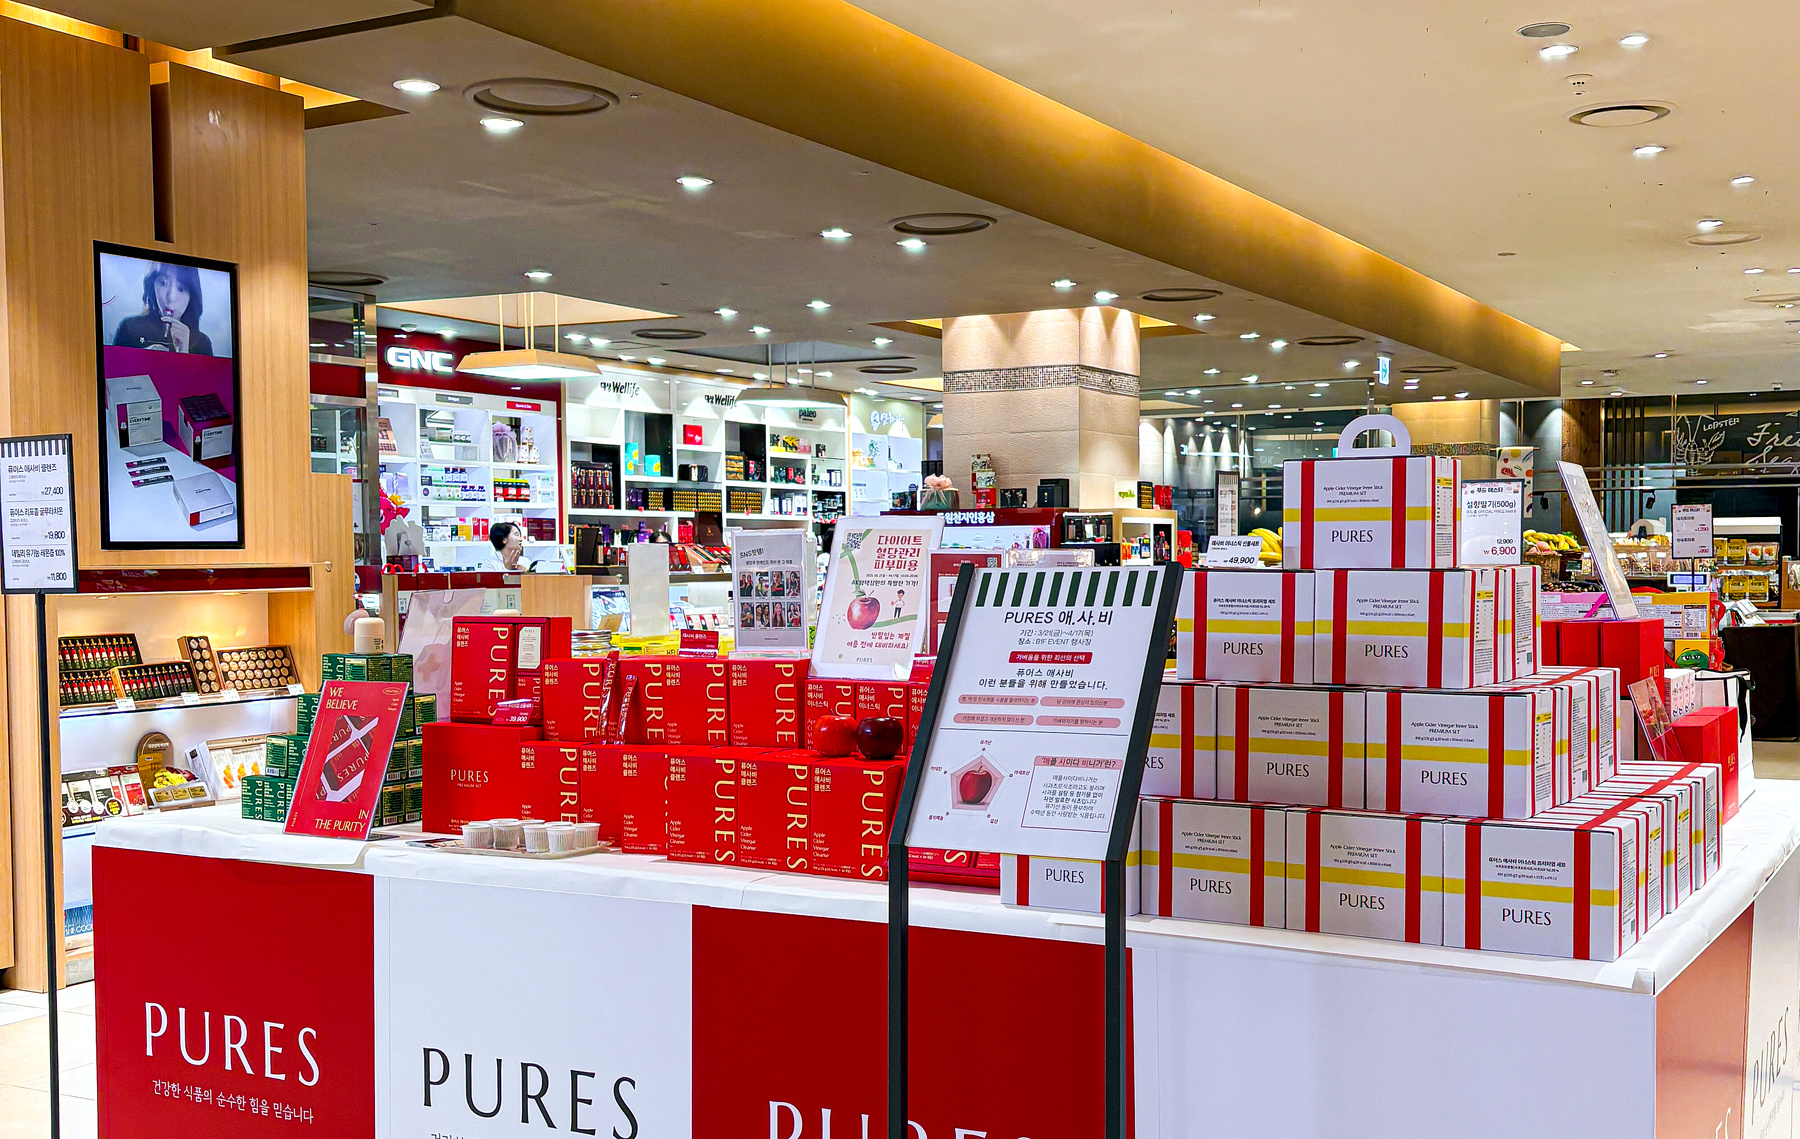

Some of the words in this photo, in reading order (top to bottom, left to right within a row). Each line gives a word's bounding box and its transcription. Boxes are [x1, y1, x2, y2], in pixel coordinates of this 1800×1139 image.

[386, 346, 453, 373] GNC
[612, 382, 640, 398] Wellife
[798, 408, 817, 419] paleo
[1703, 417, 1740, 431] LOBSTER
[877, 535, 922, 546] 다이어트
[1331, 529, 1373, 543] PURES
[876, 547, 921, 559] 혈당관리
[873, 560, 918, 571] 피부미용
[1004, 611, 1054, 624] PURES
[1058, 610, 1113, 625] 애.사.비
[1018, 638, 1031, 646] 장소
[1071, 638, 1092, 646] 행사장
[1223, 642, 1264, 656] PURES
[1364, 644, 1408, 658] PURES
[1015, 669, 1043, 678] 퓨어스
[1046, 669, 1074, 678] 애사비
[978, 678, 997, 688] 이런
[998, 679, 1026, 688] 분들을
[1029, 679, 1047, 689] 위해
[1050, 679, 1108, 691] 만들었습니다.
[329, 687, 344, 698] WE
[326, 698, 358, 711] BELIEVE
[1058, 758, 1079, 767] 사이다
[1266, 762, 1310, 778] PURES
[450, 769, 489, 783] PURES
[1421, 770, 1468, 786] PURES
[277, 783, 285, 822] PURES
[358, 809, 370, 820] IN
[714, 759, 735, 862] PURES
[786, 765, 808, 870] PURES
[315, 818, 332, 830] THE
[333, 819, 367, 833] PURITY
[861, 770, 884, 878] PURES
[1045, 868, 1085, 884] PURES
[1190, 878, 1232, 894] PURES
[1339, 893, 1385, 910] PURES
[1502, 908, 1552, 926] PURES
[145, 1002, 320, 1087] PURES
[1752, 1006, 1789, 1126] PURES
[422, 1047, 639, 1139] PURES
[152, 1080, 182, 1099] 건강한
[183, 1086, 213, 1105] 식품의
[215, 1091, 247, 1111] 순수한
[249, 1097, 270, 1116] 힘을
[273, 1102, 314, 1125] 믿습니다
